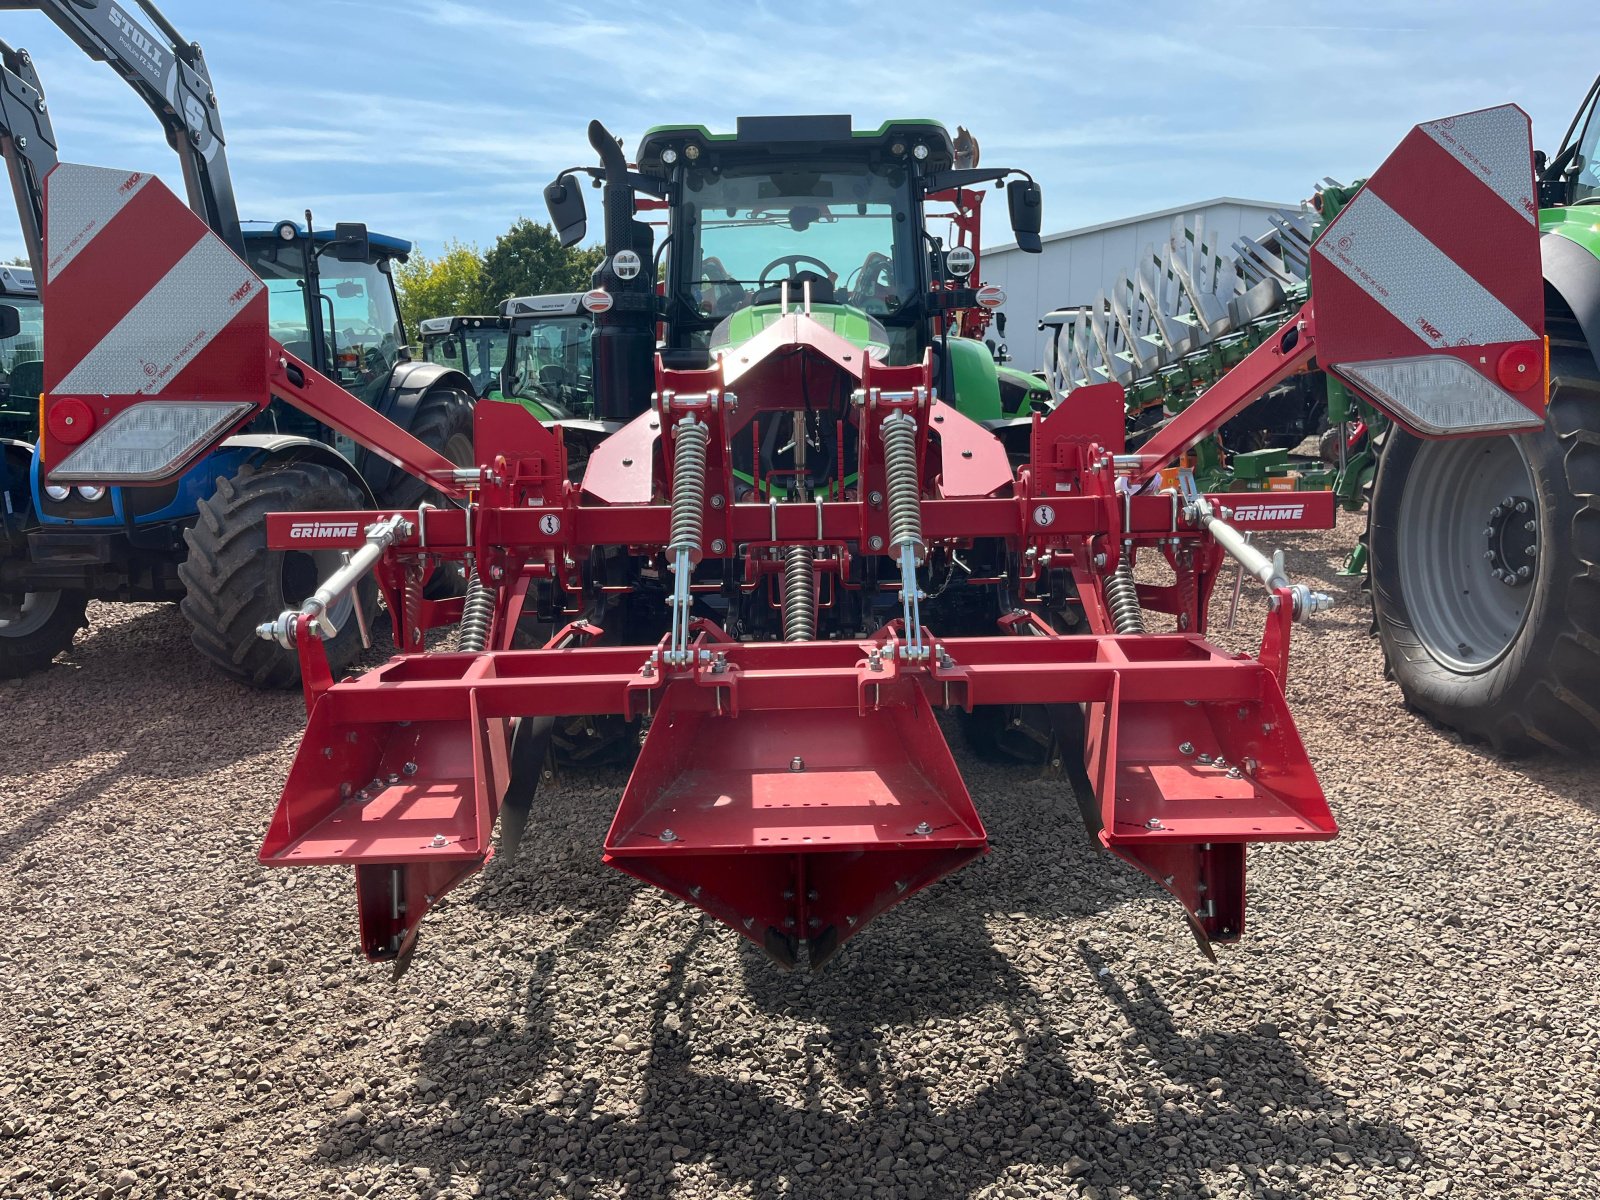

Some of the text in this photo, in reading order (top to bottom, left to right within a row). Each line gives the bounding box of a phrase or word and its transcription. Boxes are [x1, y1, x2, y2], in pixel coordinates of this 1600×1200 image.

[109, 6, 162, 68] STOLL
[234, 281, 253, 300] WGF
[1421, 322, 1443, 340] WGF
[1234, 504, 1304, 521] GRIMME
[290, 522, 358, 538] GRIMME
